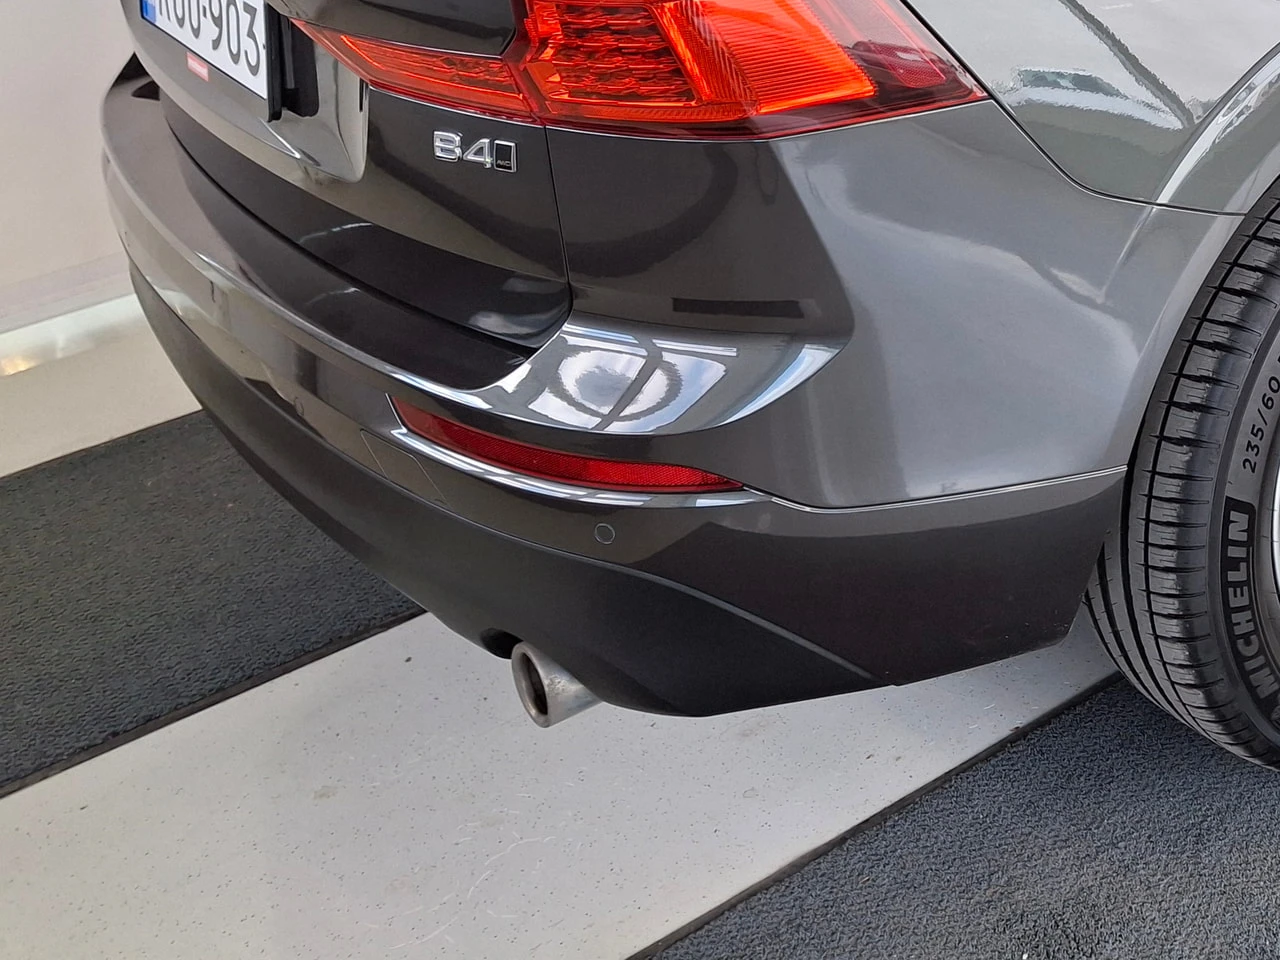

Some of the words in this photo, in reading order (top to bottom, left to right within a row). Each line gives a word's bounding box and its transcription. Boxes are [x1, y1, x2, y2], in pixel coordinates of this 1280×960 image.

[433, 130, 493, 169] B4
[1242, 375, 1280, 474] 235/60
[1227, 510, 1280, 700] MICHELIN
